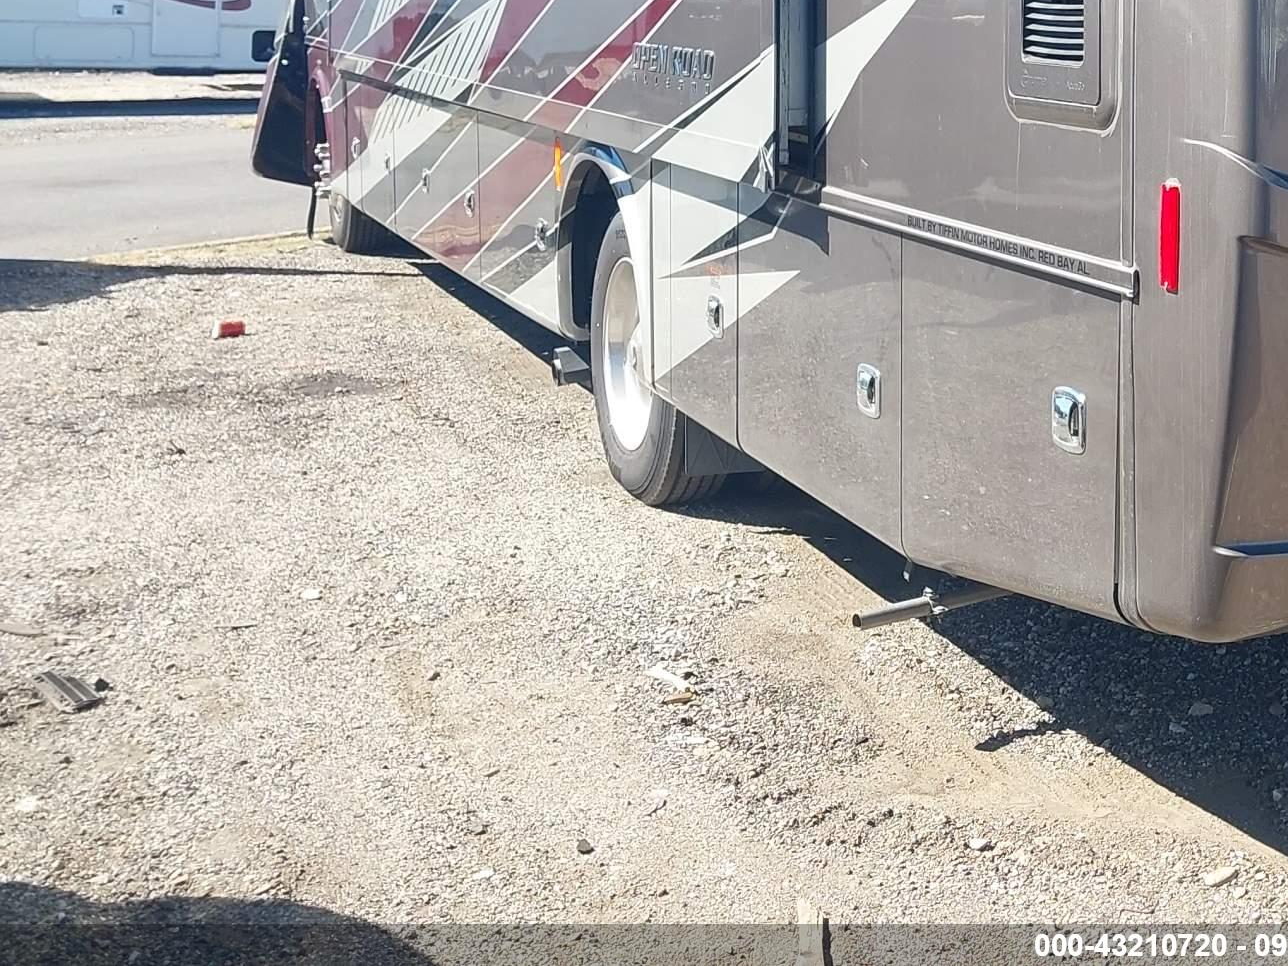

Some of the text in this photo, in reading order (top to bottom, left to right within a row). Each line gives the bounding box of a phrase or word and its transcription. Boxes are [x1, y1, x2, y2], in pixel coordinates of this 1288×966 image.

[632, 42, 715, 80] OPEN ROAD
[907, 215, 927, 229] BUILT
[928, 220, 938, 233] BY
[938, 223, 960, 240] TIFFIN
[961, 228, 988, 247] MOTOR
[989, 235, 1018, 255] HOMES
[1038, 249, 1056, 265] RED
[1057, 255, 1076, 272] BAY
